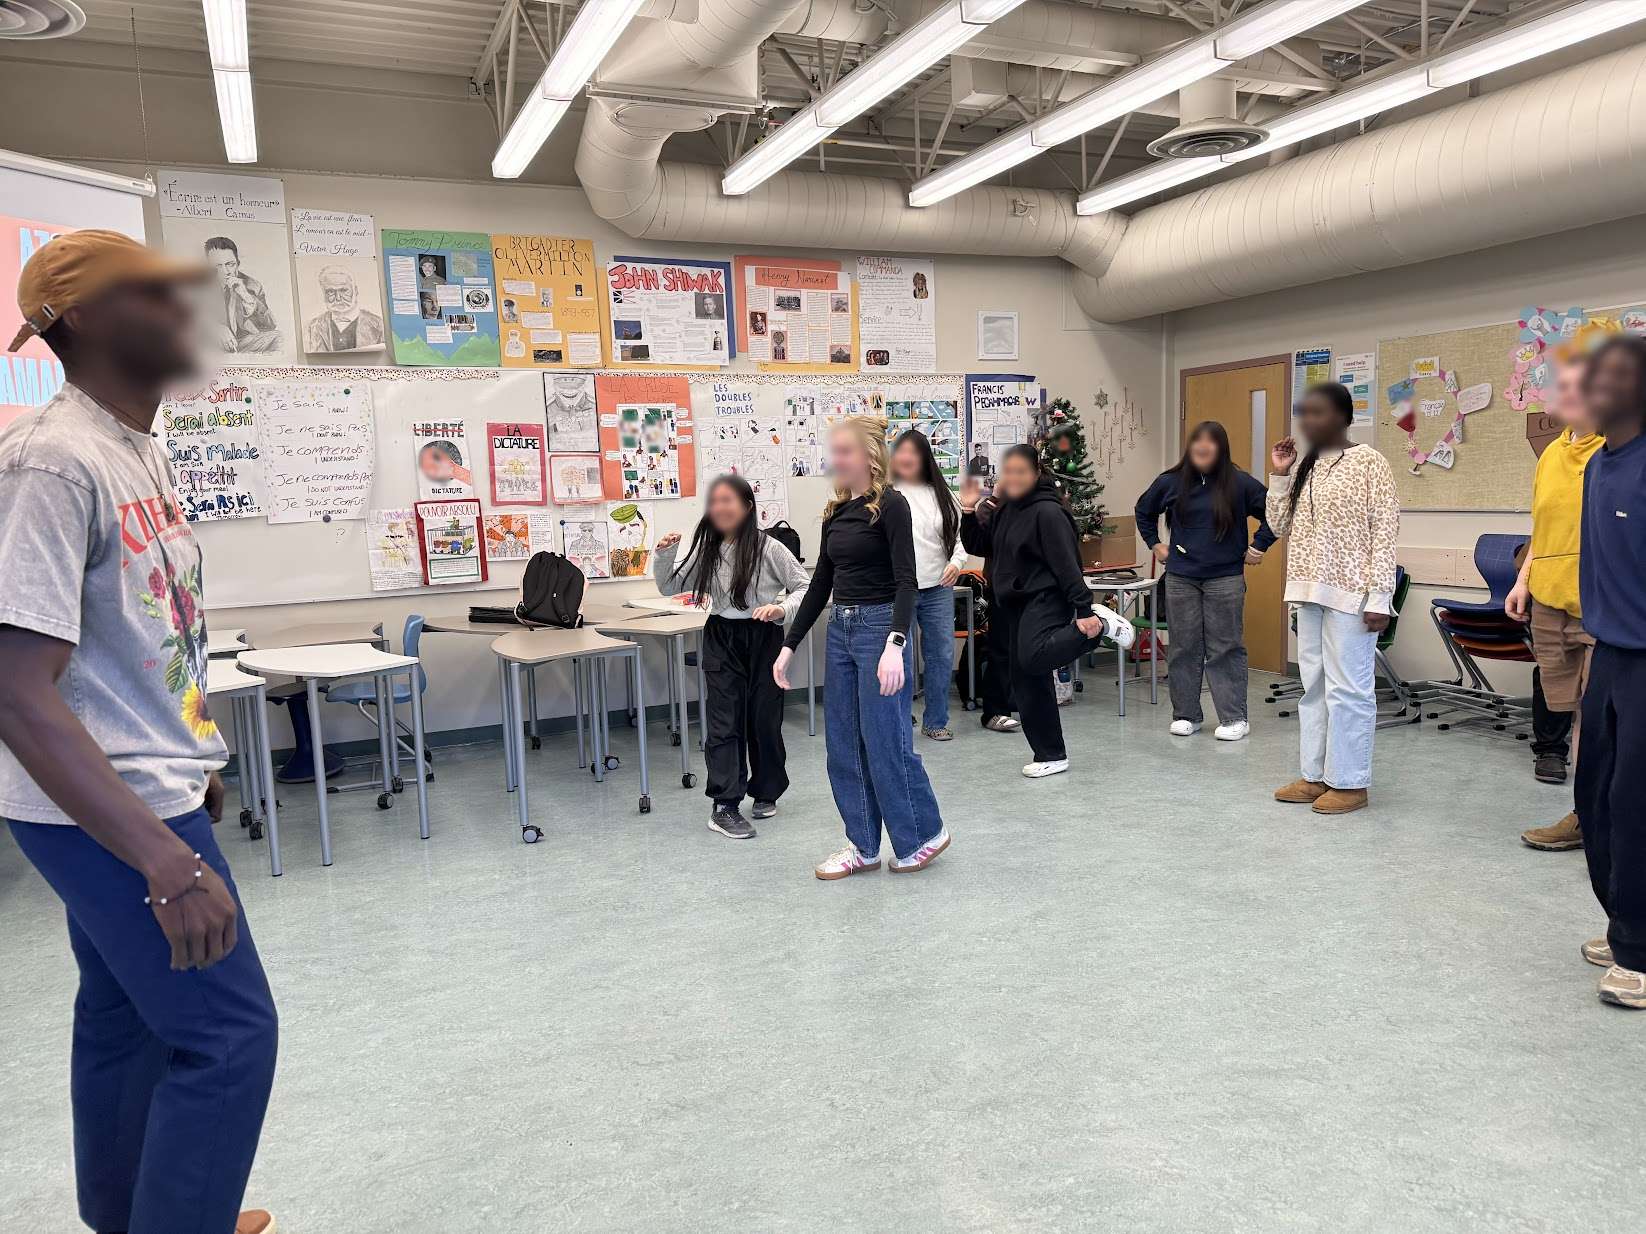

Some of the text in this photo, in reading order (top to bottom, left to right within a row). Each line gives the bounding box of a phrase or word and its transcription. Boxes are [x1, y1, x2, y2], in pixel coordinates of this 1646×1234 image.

[222, 195, 235, 204] un
[225, 207, 256, 219] Camus
[330, 244, 360, 256] Hugo
[509, 236, 576, 252] BRIGADIER
[507, 258, 583, 276] MARTIN
[856, 256, 893, 267] WILLIAM
[608, 264, 725, 294] JOHN SHIWAK
[762, 268, 790, 288] Henry
[713, 384, 728, 393] LES
[972, 383, 1006, 395] FRANCIS
[714, 391, 752, 403] DOUBLES
[272, 399, 288, 411] Je
[715, 403, 754, 415] TROUBLES
[162, 406, 254, 431] Serai absent
[275, 424, 294, 435] Je
[299, 425, 317, 433] ne
[413, 420, 465, 438] LIBERTÉ
[493, 437, 540, 450] DICTATURE
[167, 440, 260, 463] Suis Malade
[275, 445, 294, 456] Je
[275, 473, 294, 487] Je
[295, 473, 312, 483] ne
[280, 497, 300, 512] Je
